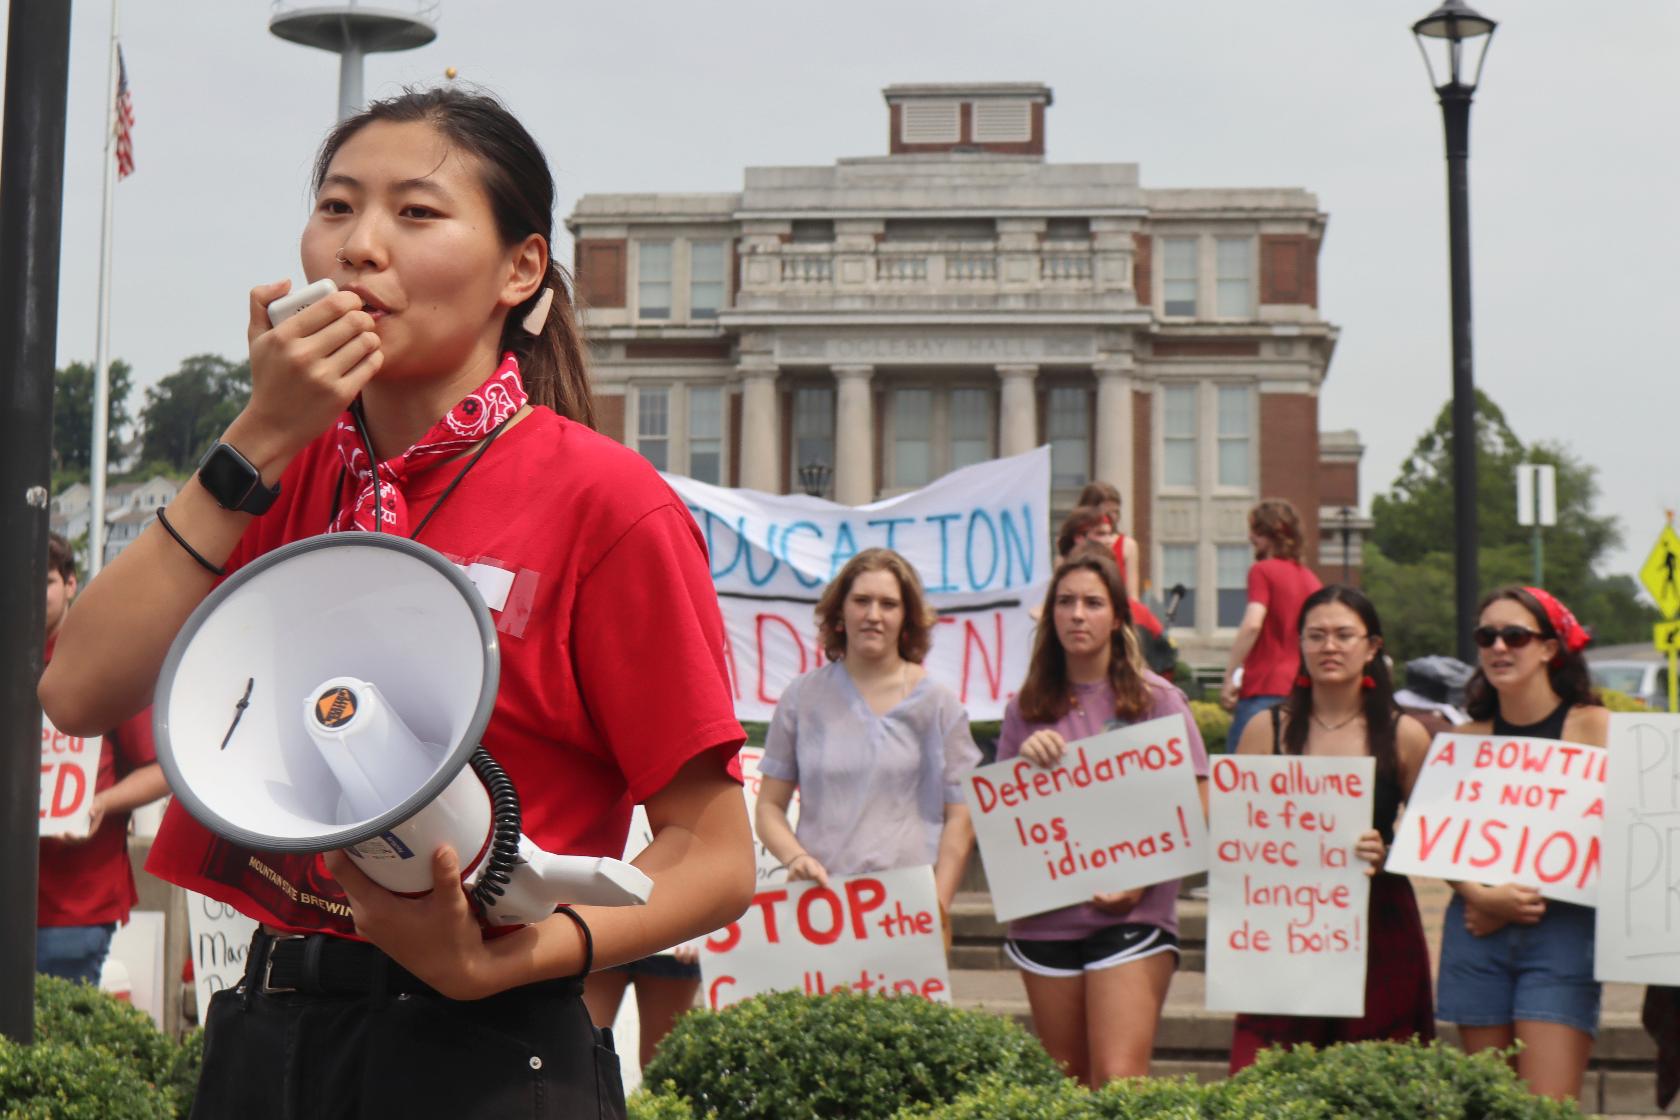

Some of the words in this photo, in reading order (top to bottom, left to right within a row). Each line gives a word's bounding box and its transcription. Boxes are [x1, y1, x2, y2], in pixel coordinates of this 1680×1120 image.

[967, 338, 1033, 358] HALL
[687, 502, 1035, 593] DUCATION
[1430, 742, 1456, 767] A
[971, 737, 1184, 814] Defendamos
[1213, 759, 1259, 794] On
[1270, 761, 1363, 797] allume
[1247, 801, 1270, 829] le
[1278, 800, 1335, 832] feu
[1455, 781, 1482, 802] IS
[1500, 784, 1566, 811] NOT
[1582, 798, 1604, 821] A
[1015, 817, 1068, 846] los
[1044, 805, 1191, 880] idiomas!
[1217, 839, 1299, 867] avec
[1319, 835, 1348, 868] la
[1418, 815, 1602, 890] VISION
[248, 855, 283, 888] MOUNTAIN
[282, 879, 299, 902] STATE
[879, 901, 934, 938] the
[1243, 874, 1350, 928] langue
[1228, 920, 1271, 952] de
[1288, 915, 1361, 954] bois!
